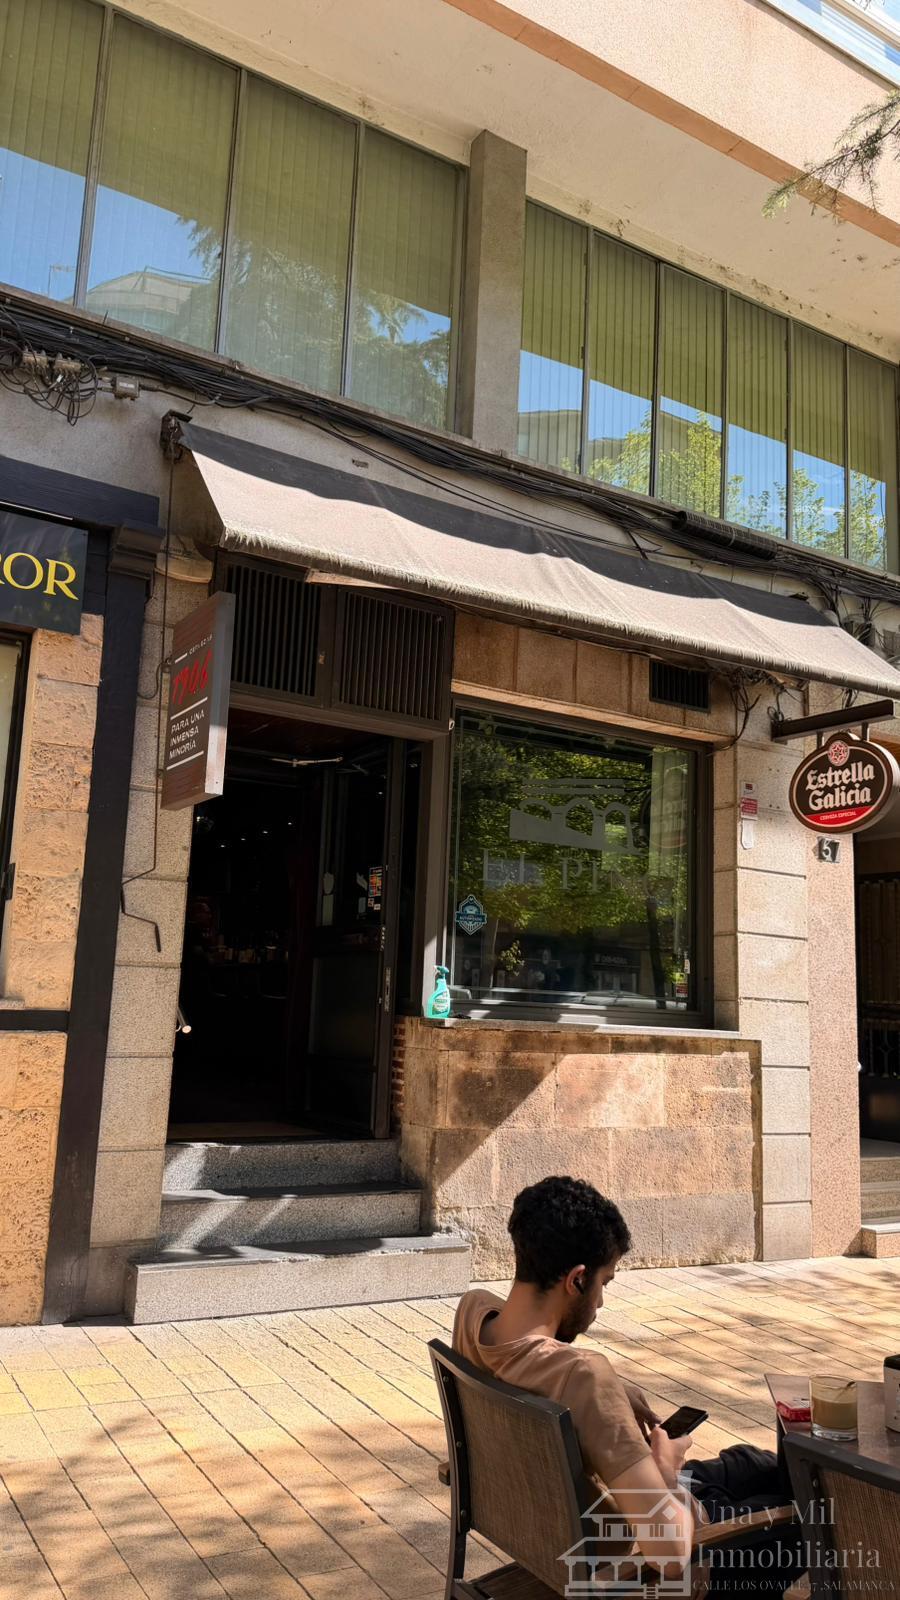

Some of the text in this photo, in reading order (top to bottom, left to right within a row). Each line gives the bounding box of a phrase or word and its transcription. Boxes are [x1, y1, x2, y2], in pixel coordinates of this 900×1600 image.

[0, 552, 79, 600] OR
[171, 709, 205, 734] PARA UNA
[169, 725, 199, 747] INMENSA
[805, 761, 875, 791] Estrella
[808, 783, 871, 811] Galicia
